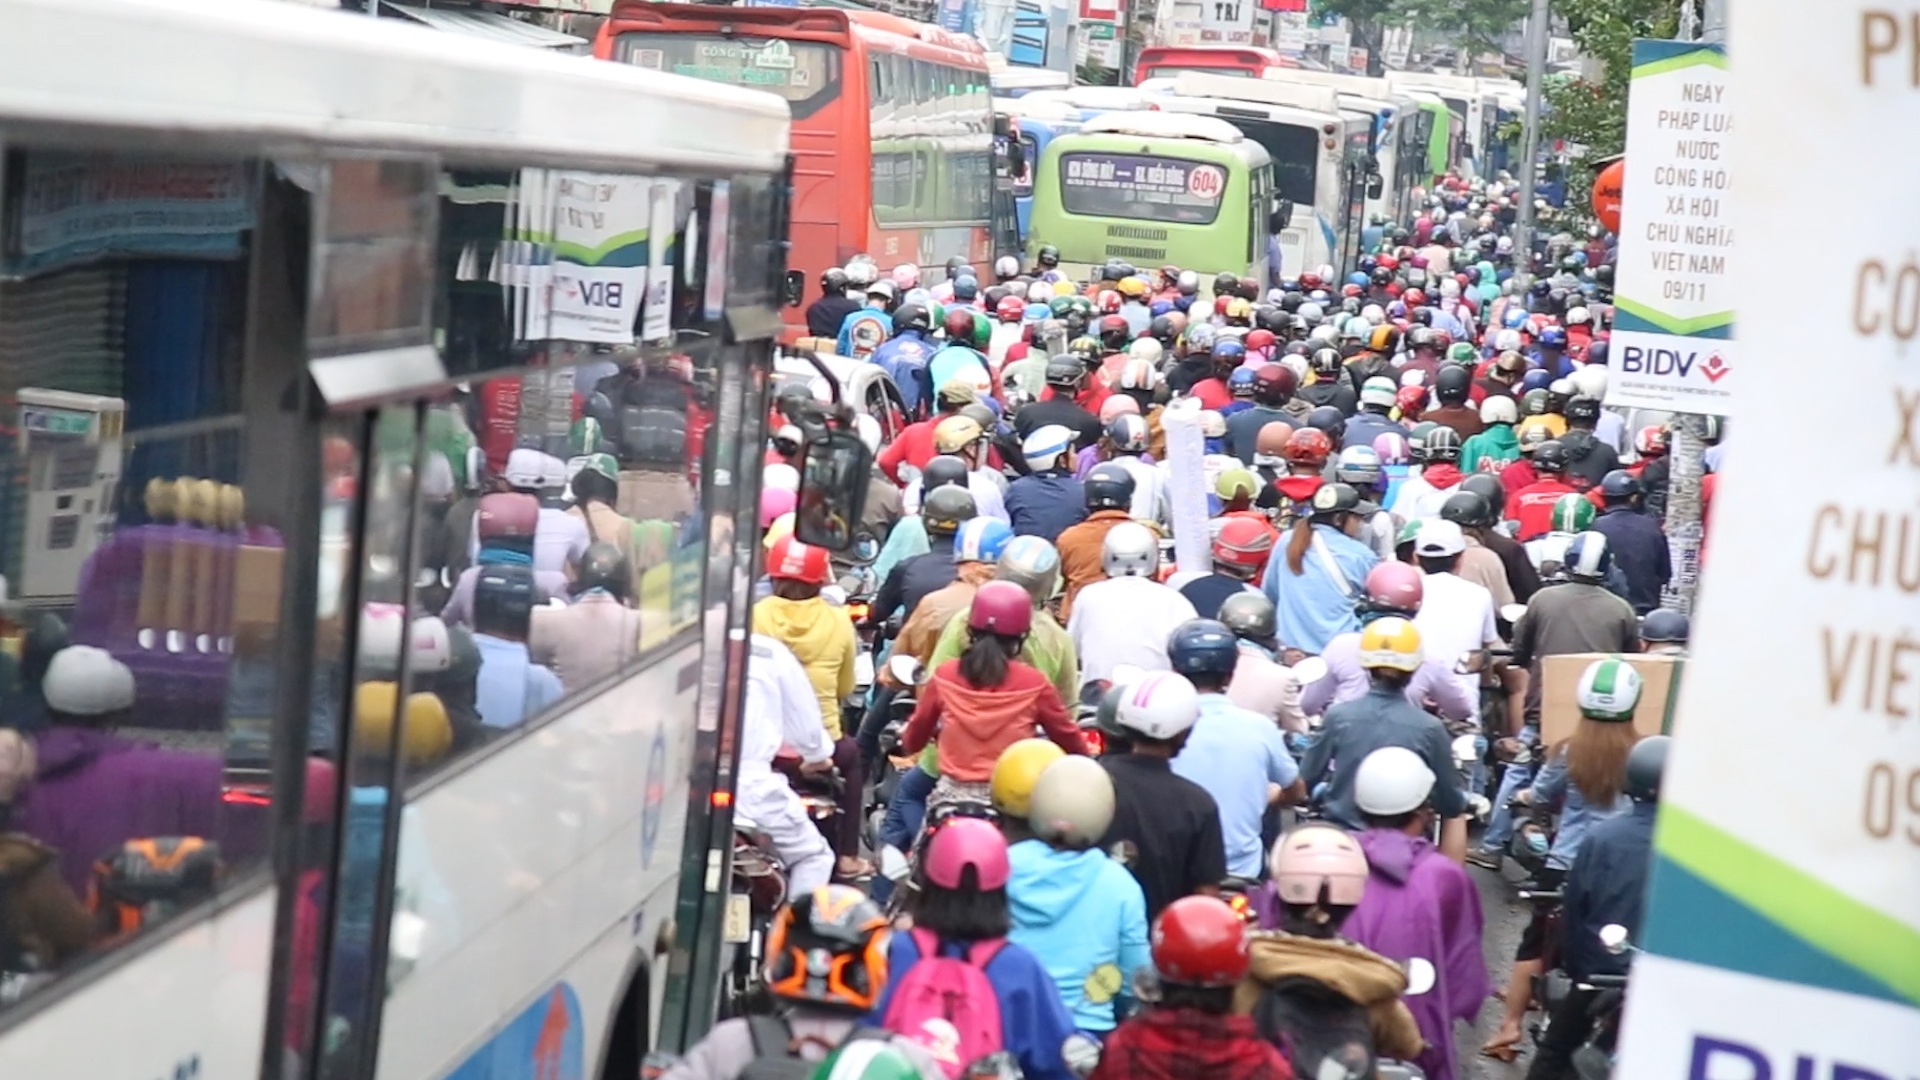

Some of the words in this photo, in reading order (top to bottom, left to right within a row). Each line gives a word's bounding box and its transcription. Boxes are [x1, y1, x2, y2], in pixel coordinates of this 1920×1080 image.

[1682, 81, 1725, 103] NGÀY
[1658, 107, 1700, 130] PHÁP
[1676, 137, 1720, 160] NƯỚC
[1192, 170, 1217, 193] 604
[1654, 164, 1697, 188] CỘNG
[1690, 195, 1719, 220] HỘI
[1651, 250, 1685, 275] VIỆT
[1688, 254, 1725, 275] NAM
[1663, 280, 1706, 301] 09/11
[1622, 346, 1697, 378] BIDV
